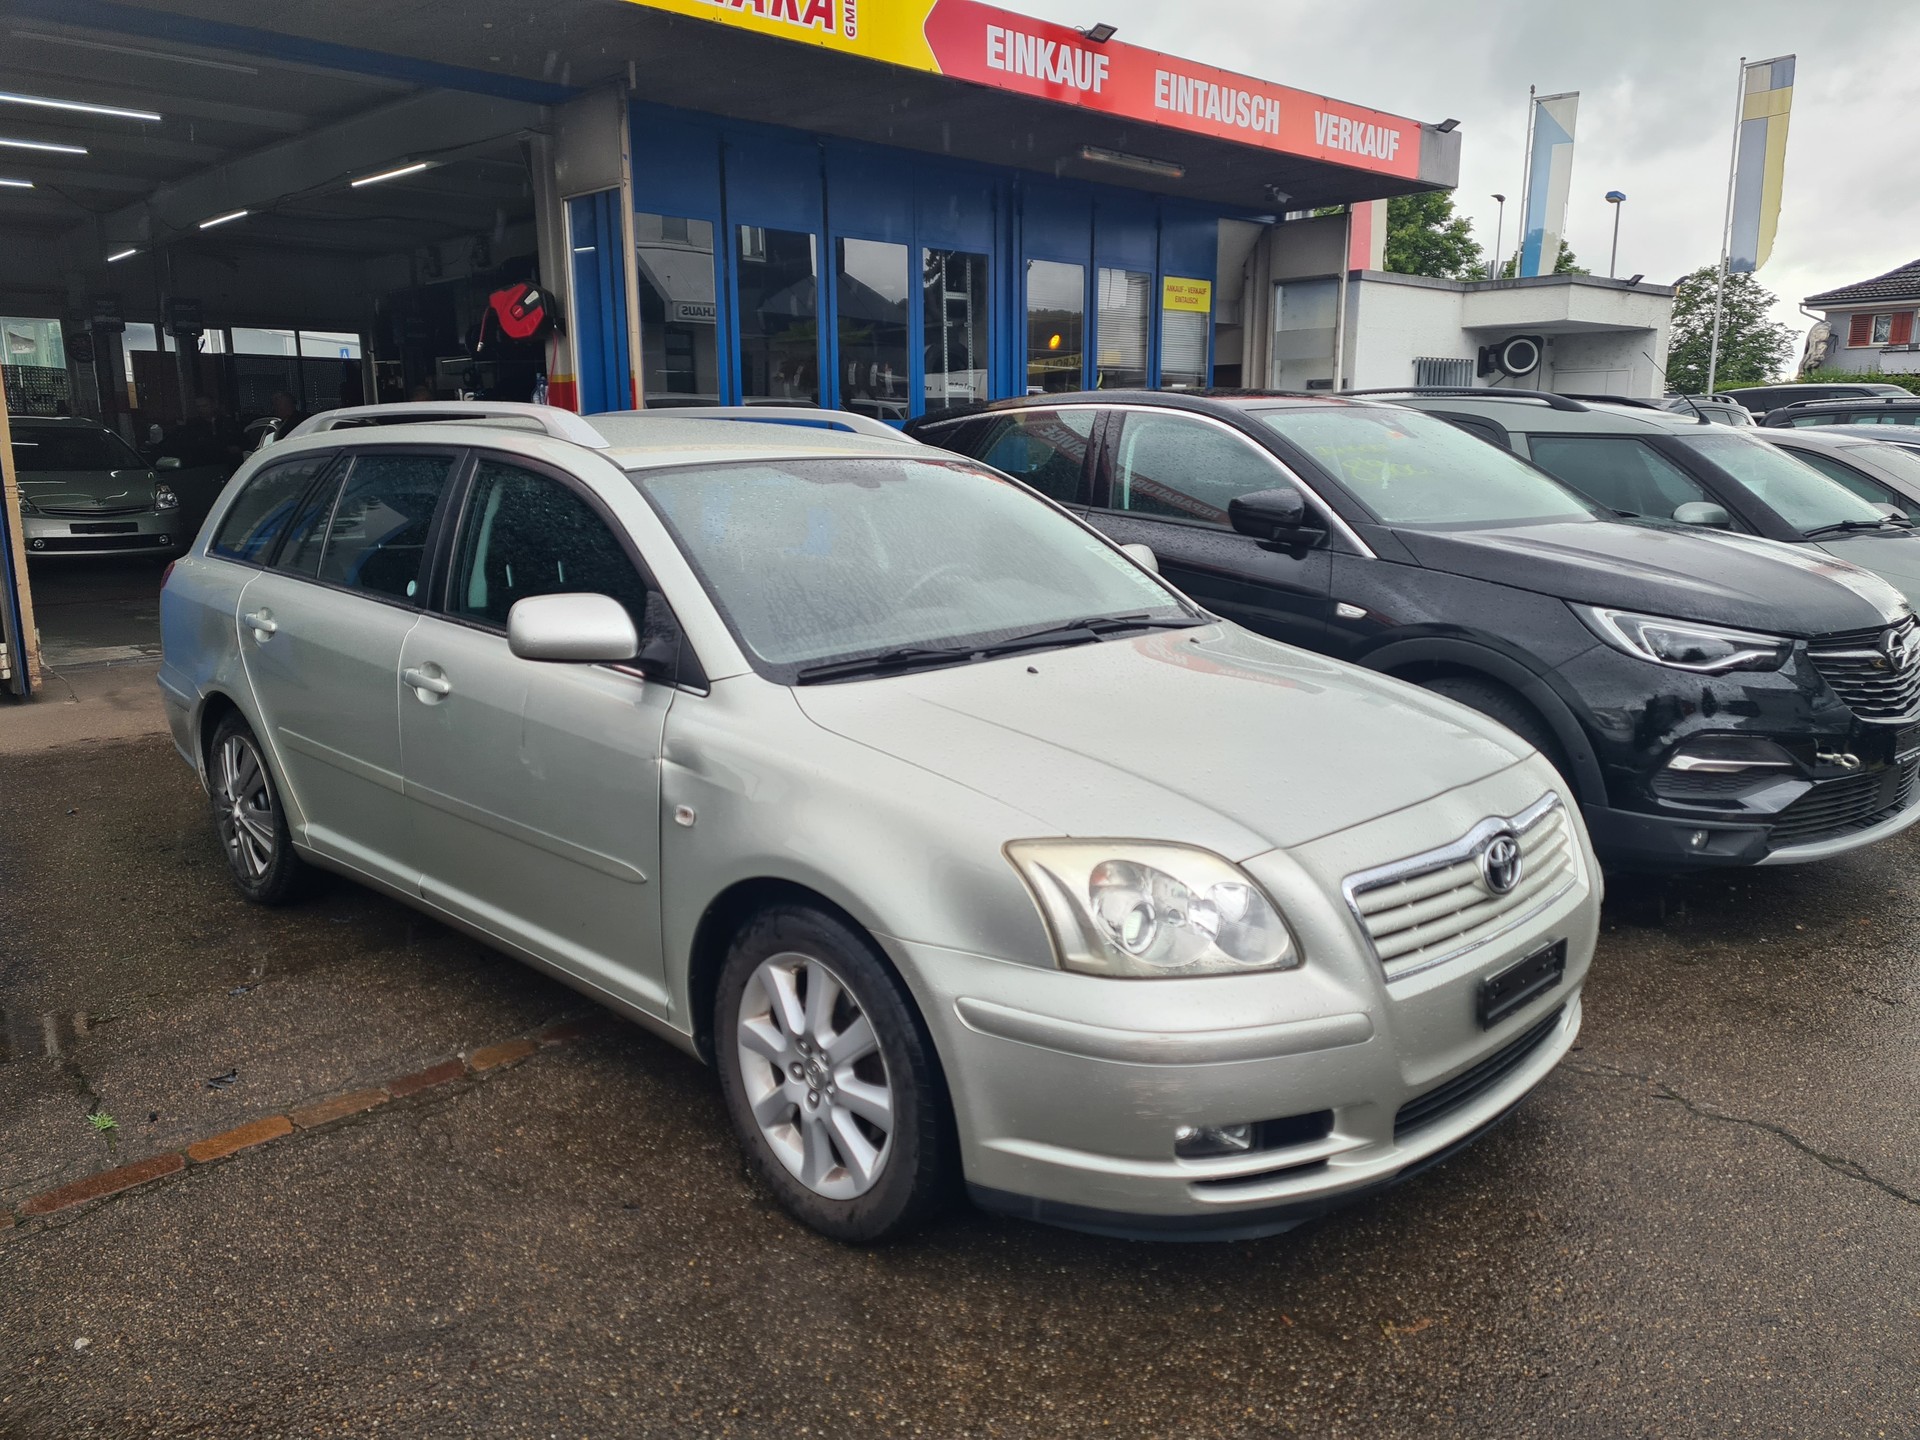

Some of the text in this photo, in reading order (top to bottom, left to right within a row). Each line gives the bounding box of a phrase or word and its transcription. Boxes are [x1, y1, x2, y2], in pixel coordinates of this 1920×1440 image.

[986, 24, 1109, 93] EINKAUF
[1155, 69, 1279, 134] EINTAUSCH
[1314, 111, 1400, 161] VERKAUF
[1175, 296, 1199, 304] EINTAUSCH
[1187, 287, 1207, 295] VERKAUF
